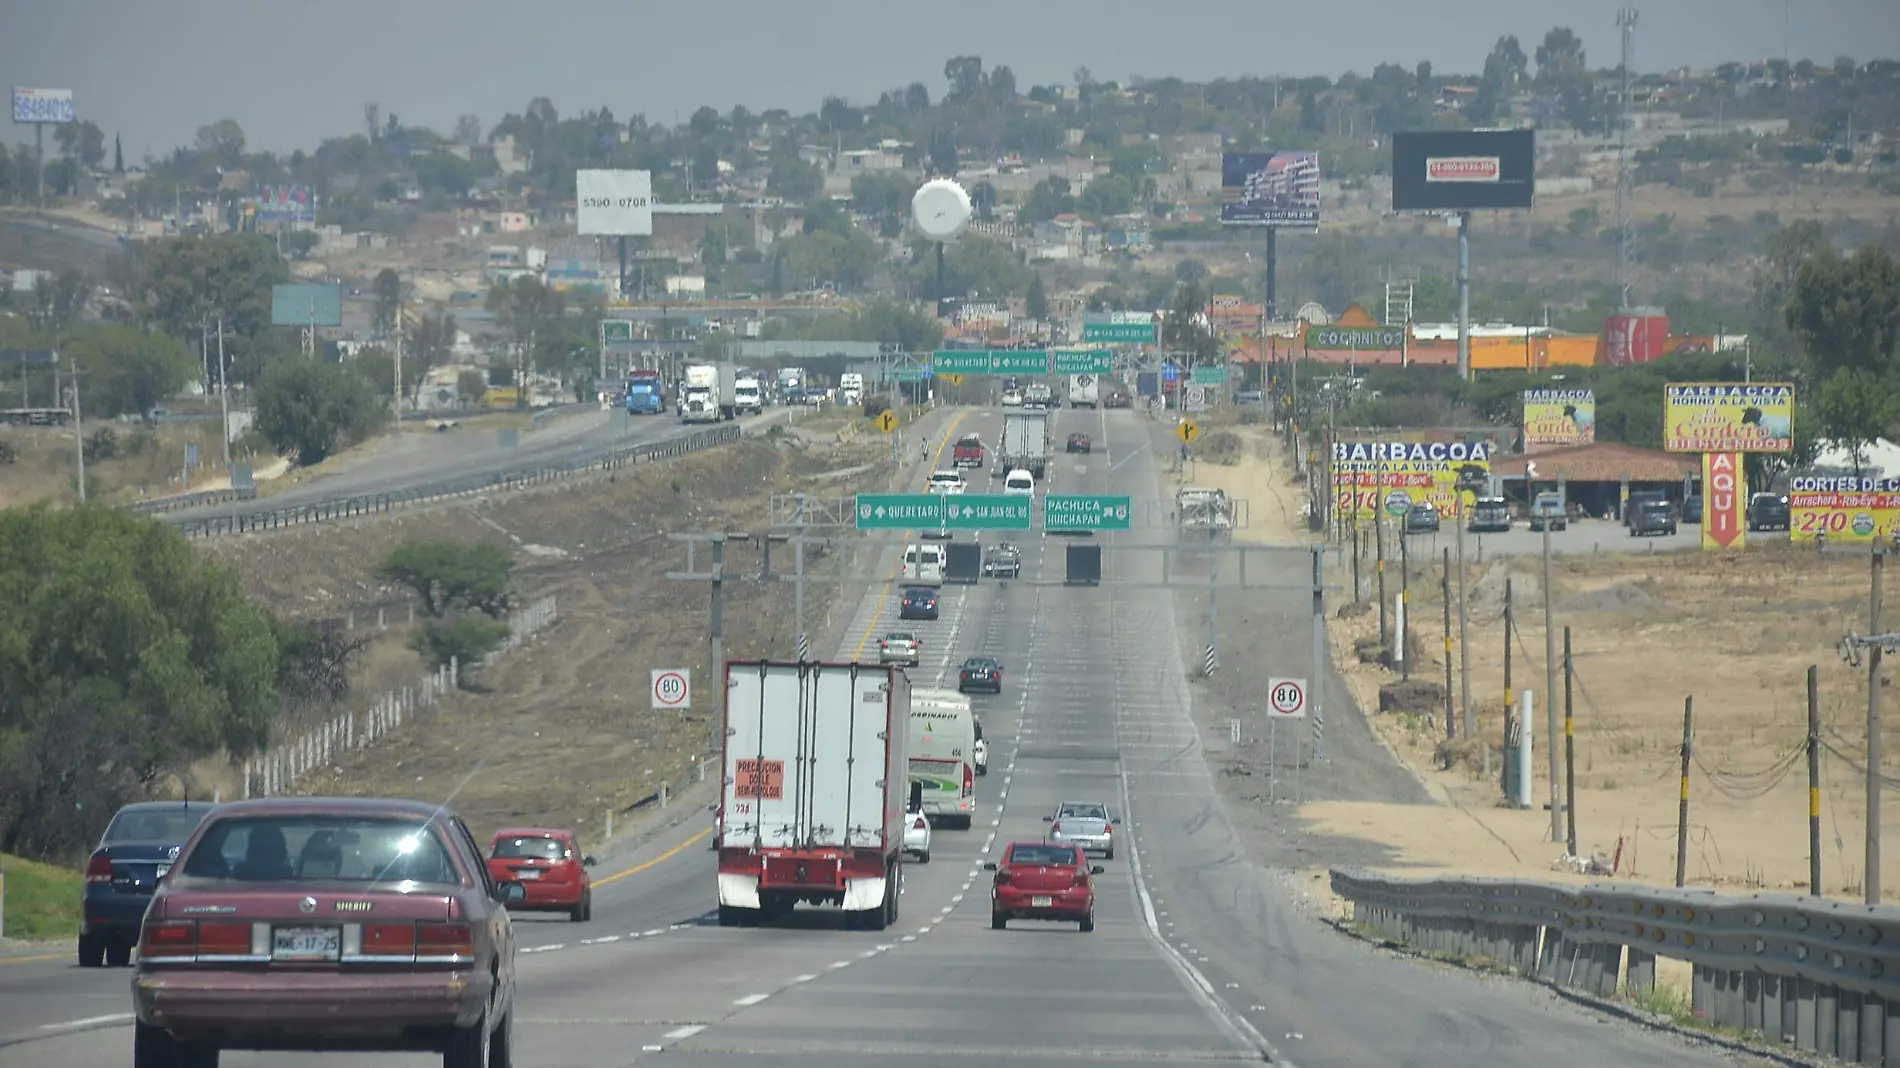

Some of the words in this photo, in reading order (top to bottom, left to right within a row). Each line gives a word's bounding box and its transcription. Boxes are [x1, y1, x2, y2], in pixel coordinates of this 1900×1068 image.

[1524, 390, 1592, 399] BARBACOA
[1668, 388, 1789, 396] BARBACOA
[1674, 421, 1770, 438] Cordero
[1332, 442, 1487, 460] BARBACOA
[1669, 440, 1789, 449] BIENVENIDOS
[1793, 476, 1858, 491] CORTES
[1862, 477, 1883, 491] DE
[1713, 453, 1734, 531] AQUI
[1047, 500, 1100, 512] PACHUCA
[1793, 495, 1837, 507] Arrachera
[888, 504, 939, 519] QUERETARO
[976, 505, 988, 519] SAN
[990, 505, 1004, 519] JUAN
[1047, 513, 1100, 526] HUICHAPAN
[663, 679, 679, 693] 80
[1277, 688, 1297, 702] 80
[749, 774, 769, 786] DOLE
[336, 901, 371, 911] SHERIFF
